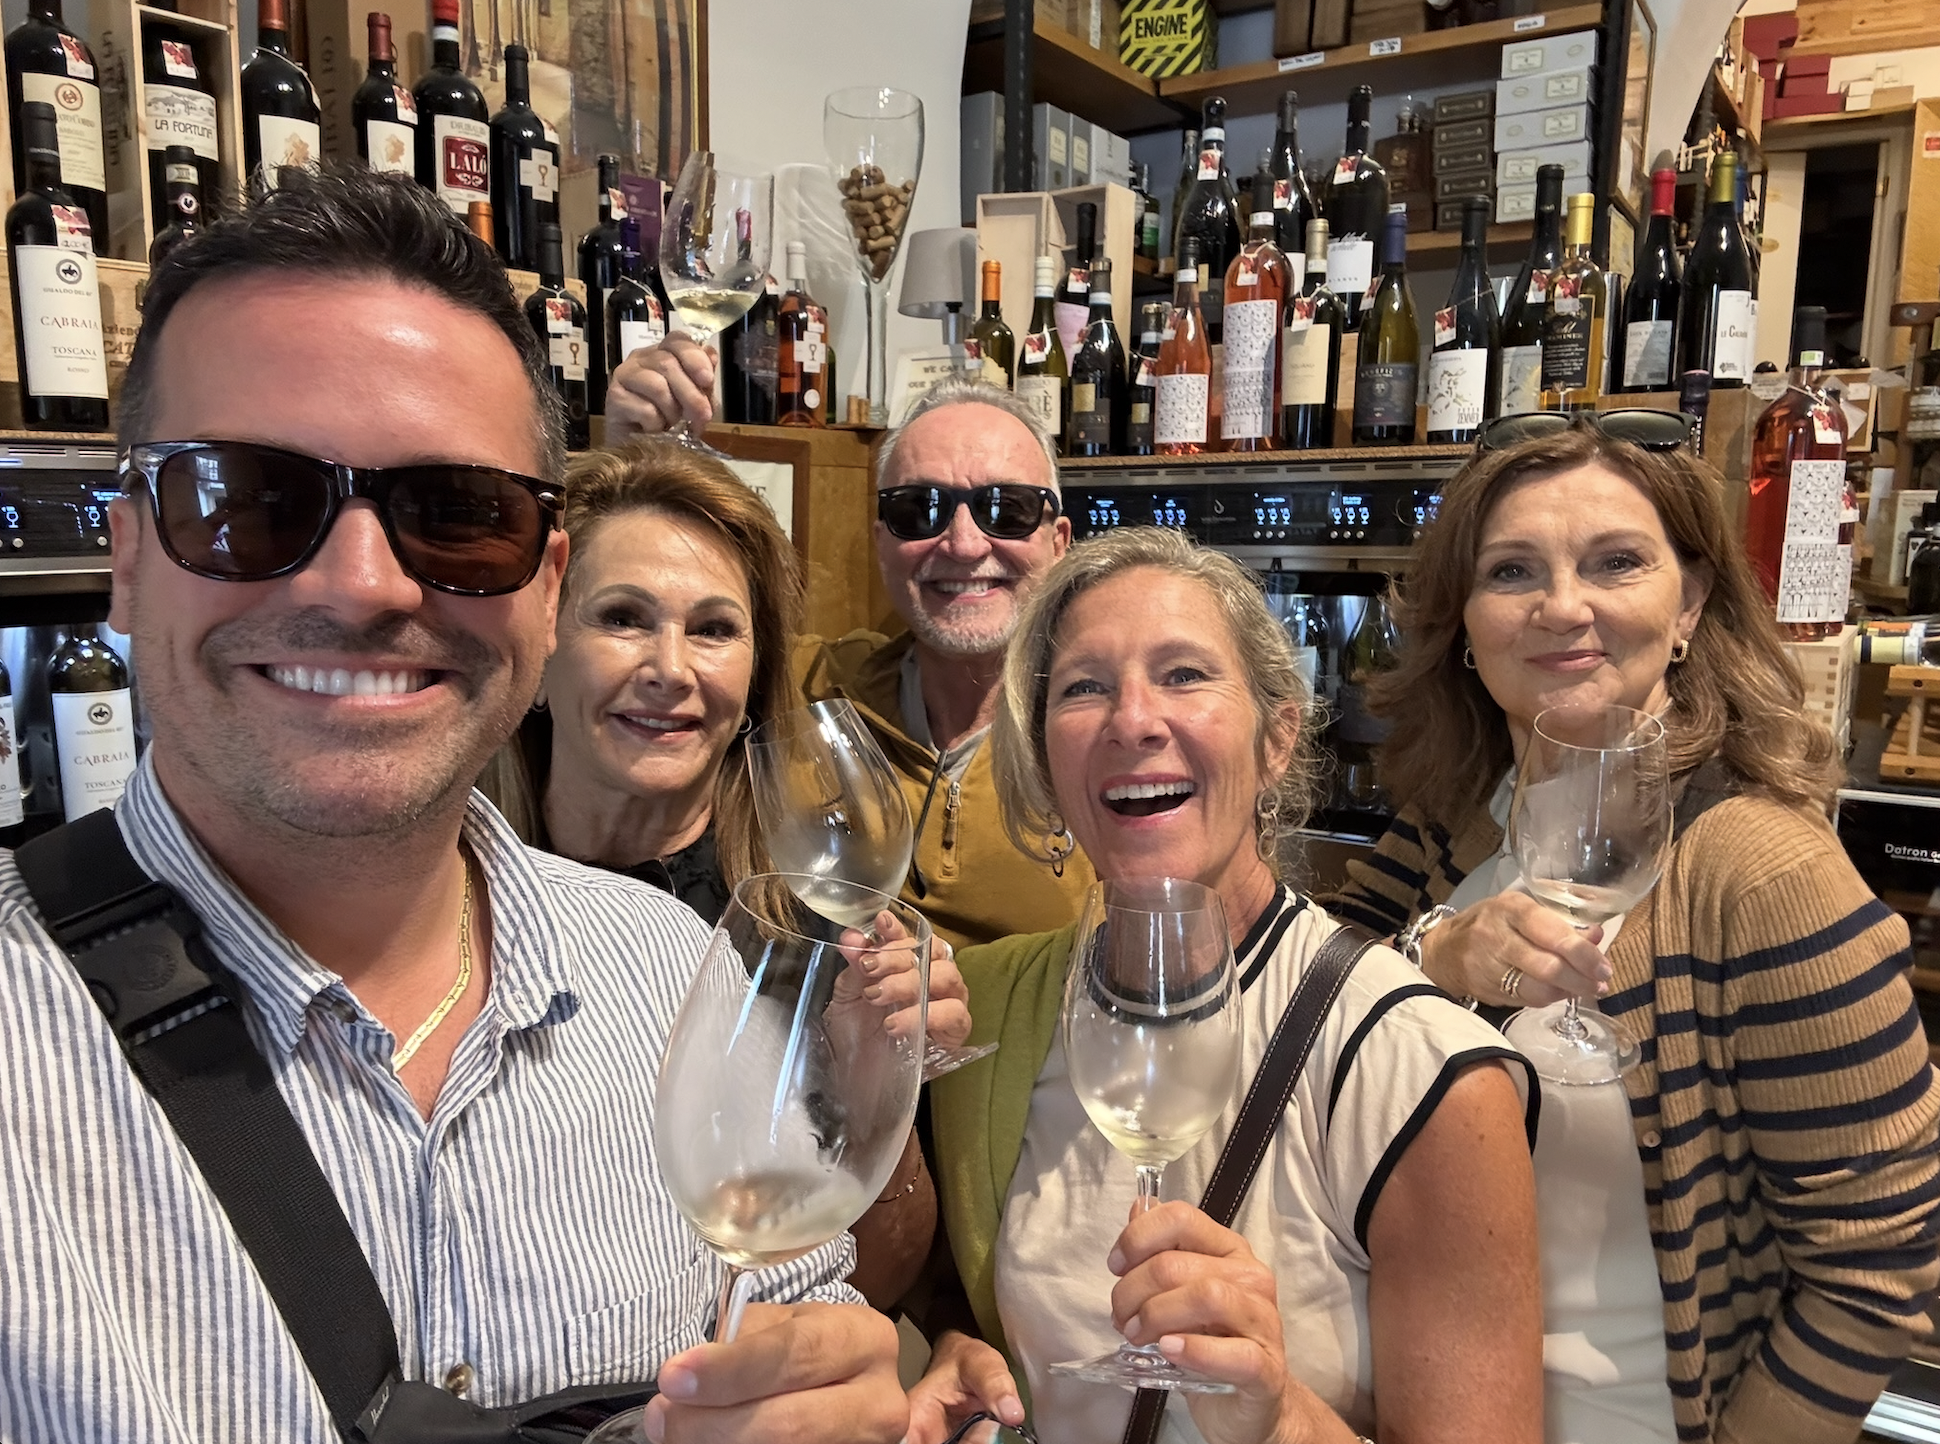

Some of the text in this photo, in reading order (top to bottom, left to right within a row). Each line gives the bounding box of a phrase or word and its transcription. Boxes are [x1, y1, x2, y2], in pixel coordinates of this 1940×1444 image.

[1135, 13, 1188, 39] ENGINE
[155, 119, 213, 139] LA FORTUNA
[40, 316, 99, 330] CABRAIA
[53, 346, 97, 356] TOSCANA
[103, 340, 135, 355] CAT
[74, 751, 130, 767] CABRAIA
